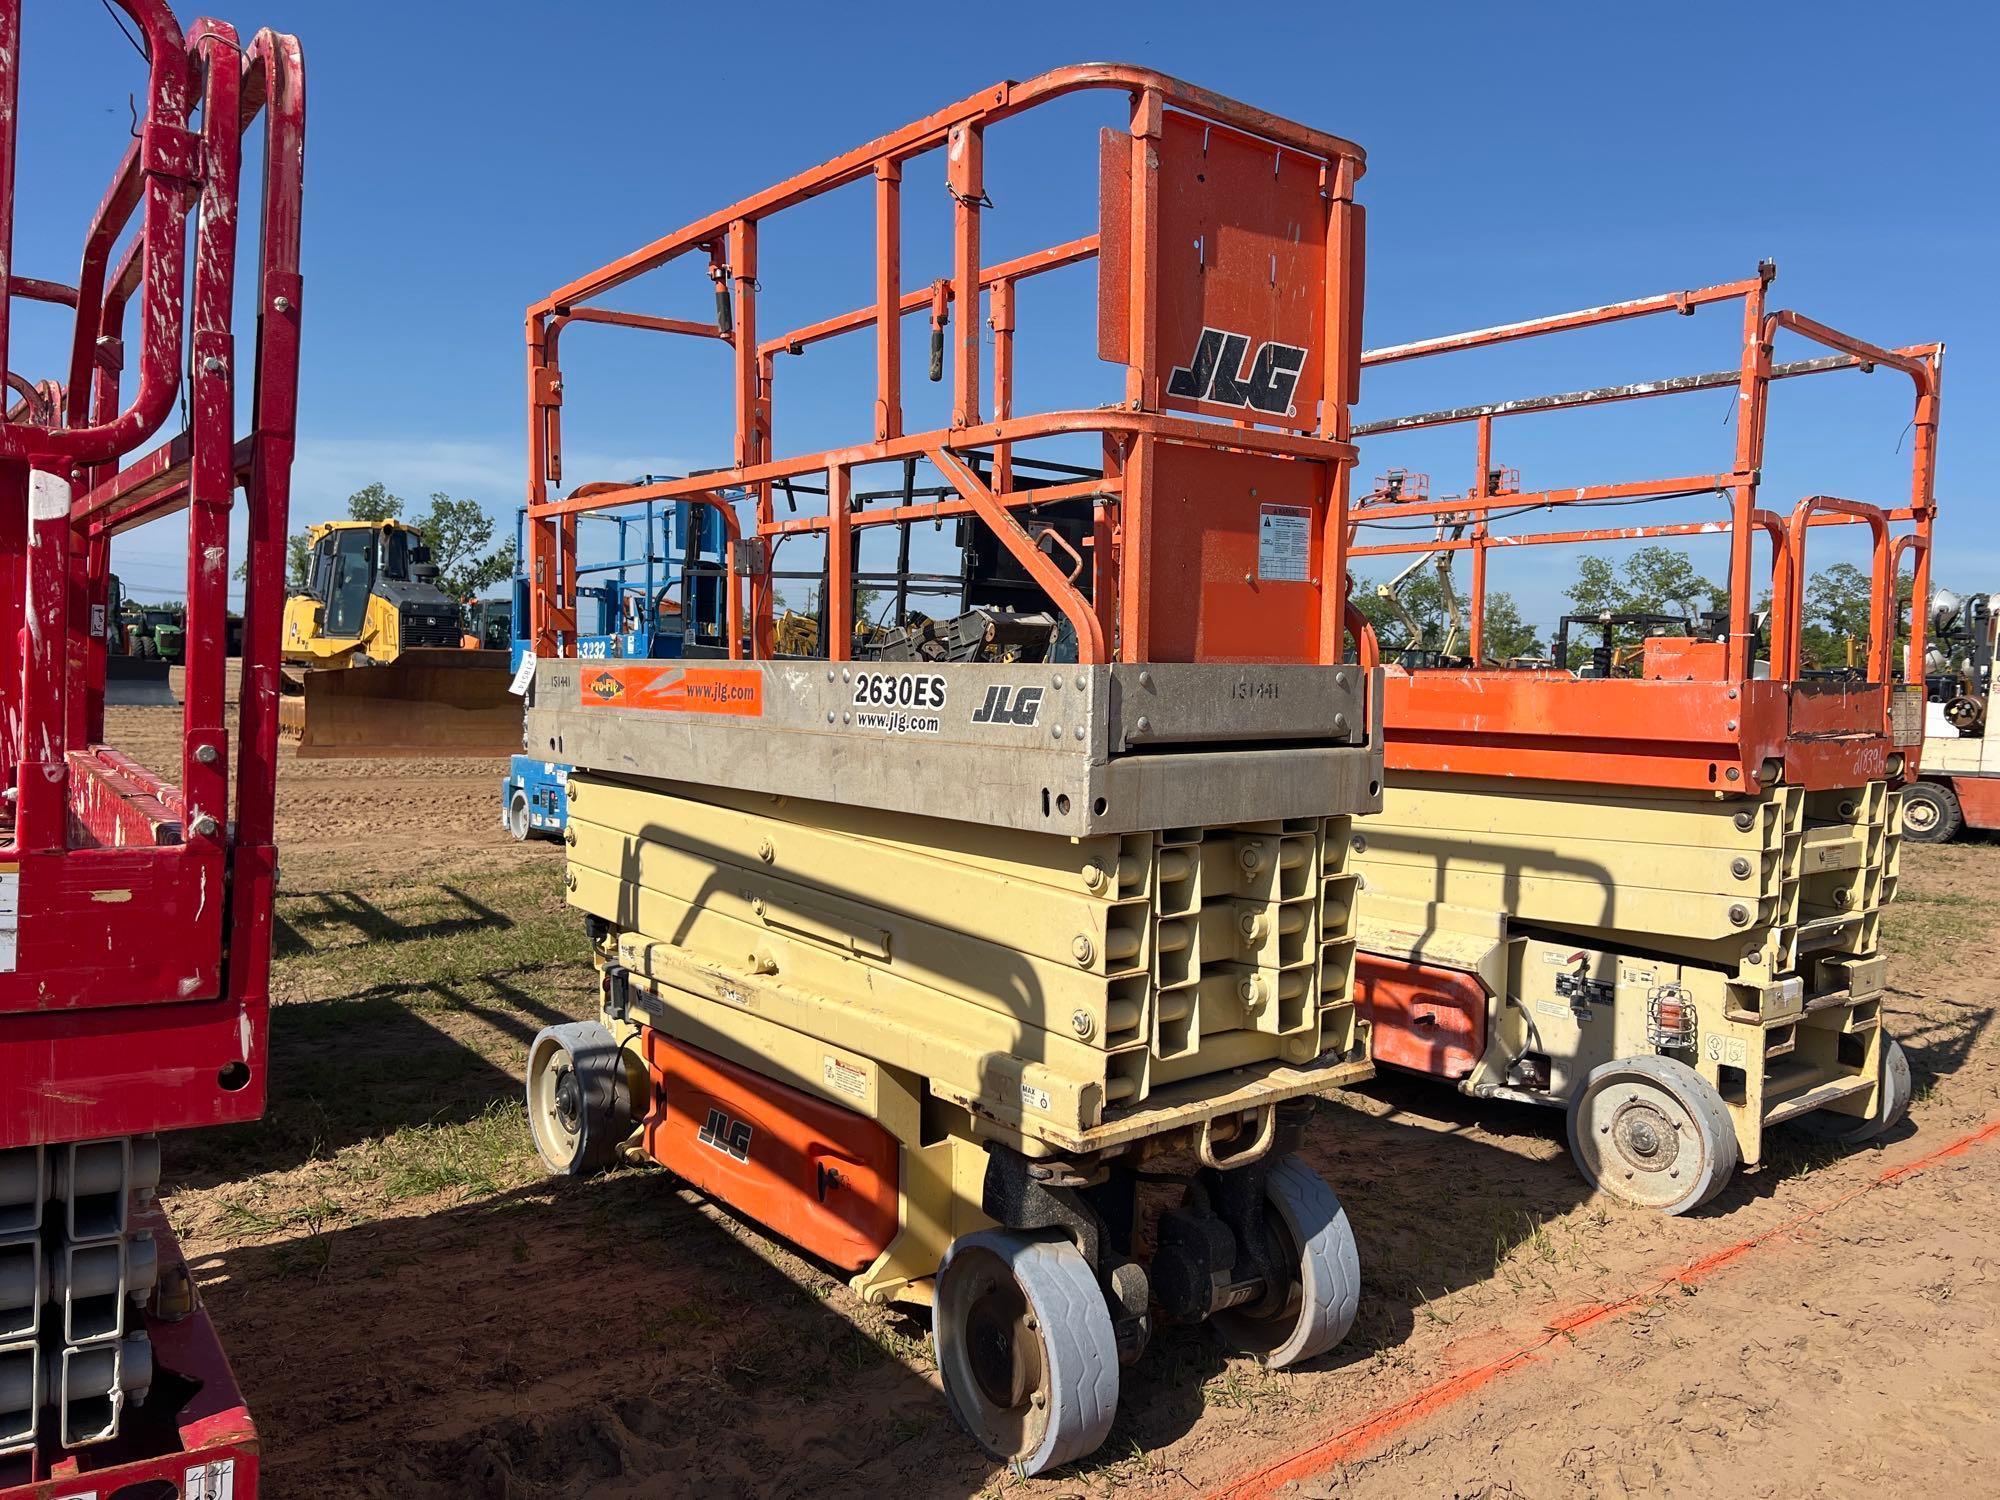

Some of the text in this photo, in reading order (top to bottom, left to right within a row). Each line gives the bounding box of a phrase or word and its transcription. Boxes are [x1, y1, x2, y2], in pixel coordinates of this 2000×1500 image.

[1166, 326, 1308, 417] JLG
[686, 682, 754, 703] www.jlg.com
[854, 673, 947, 709] 2630ES
[972, 685, 1046, 726] JLG
[857, 712, 940, 733] www.jlg.com
[697, 1107, 753, 1164] JLG
